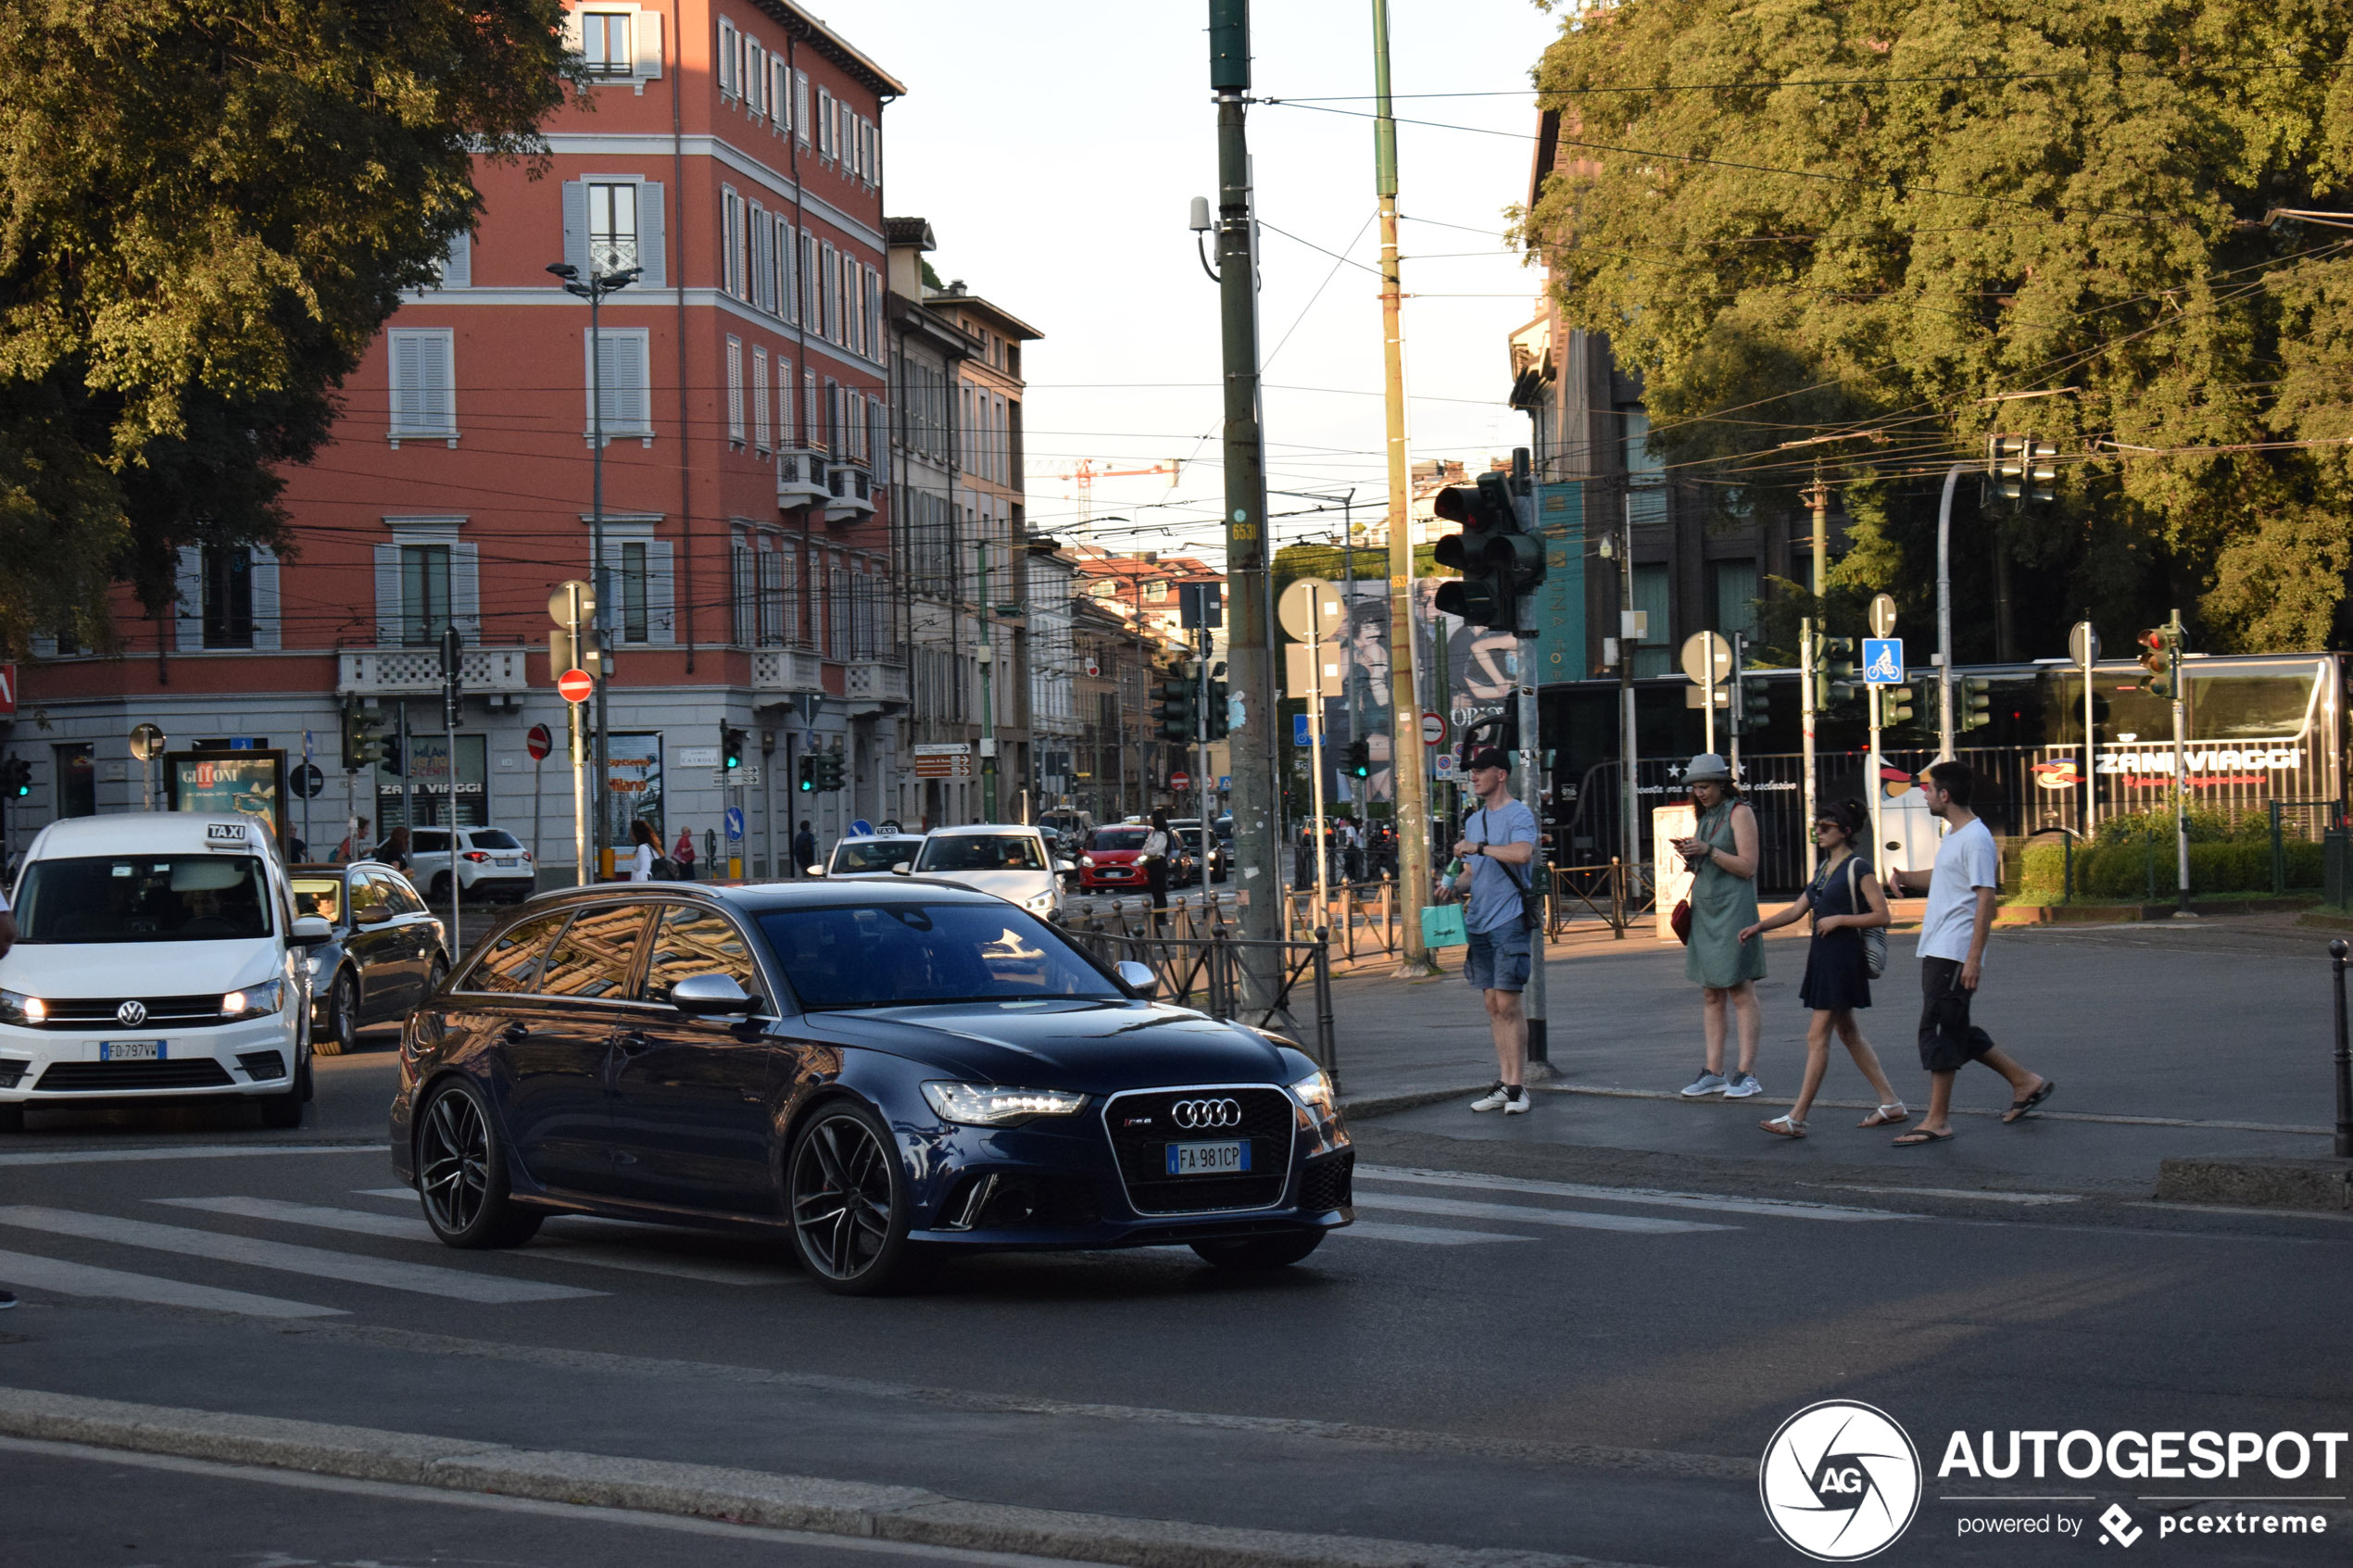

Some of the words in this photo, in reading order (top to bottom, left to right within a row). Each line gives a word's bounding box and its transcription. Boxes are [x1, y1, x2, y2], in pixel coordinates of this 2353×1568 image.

[2095, 751, 2175, 773] ZANI
[2183, 748, 2301, 771] VIAGGI
[208, 825, 245, 838] TAXI
